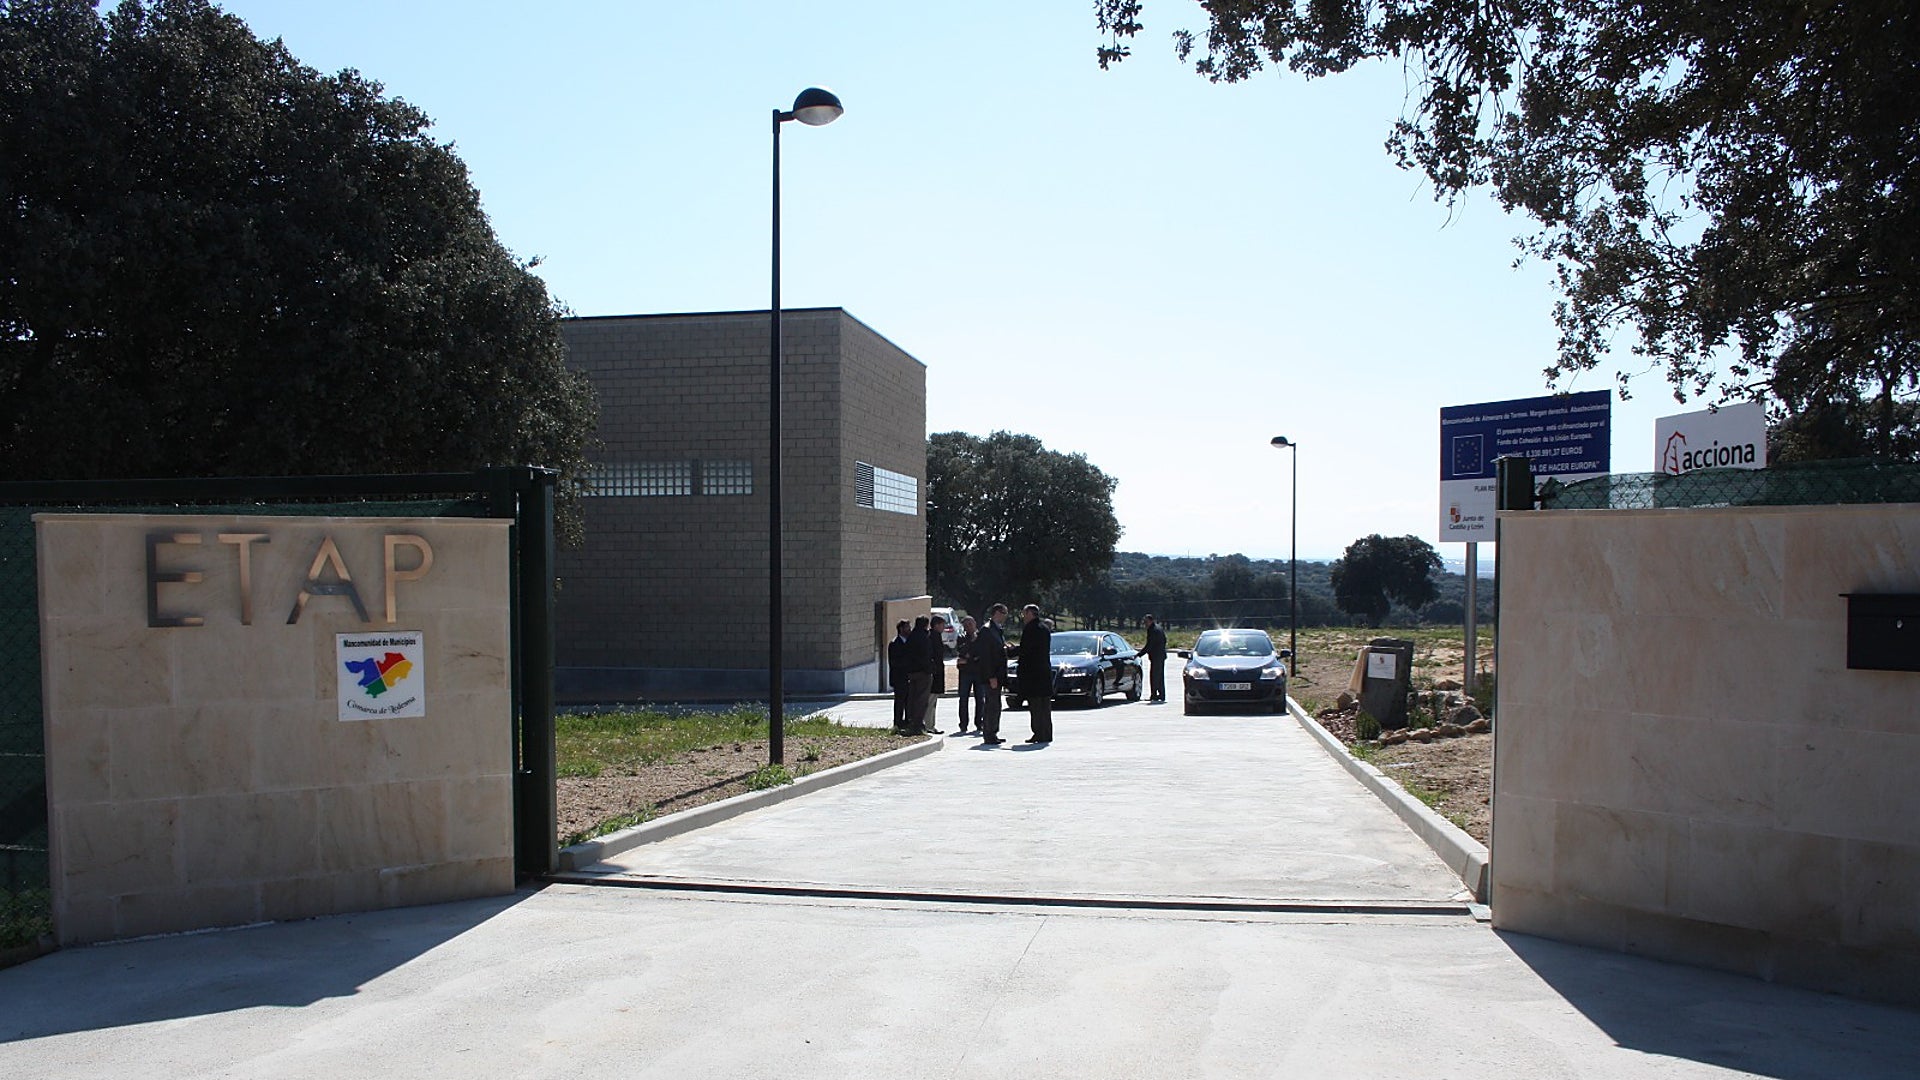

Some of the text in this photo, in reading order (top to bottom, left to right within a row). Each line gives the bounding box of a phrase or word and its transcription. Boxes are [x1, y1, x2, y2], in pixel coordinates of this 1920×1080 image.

[1561, 446, 1583, 456] EUROS
[1682, 440, 1755, 470] acciona
[1539, 464, 1548, 472] DE
[1548, 462, 1570, 472] HACER
[145, 533, 434, 628] ETAP
[343, 637, 416, 648] Mancomunidad de Municipios
[346, 699, 378, 714] Comarca
